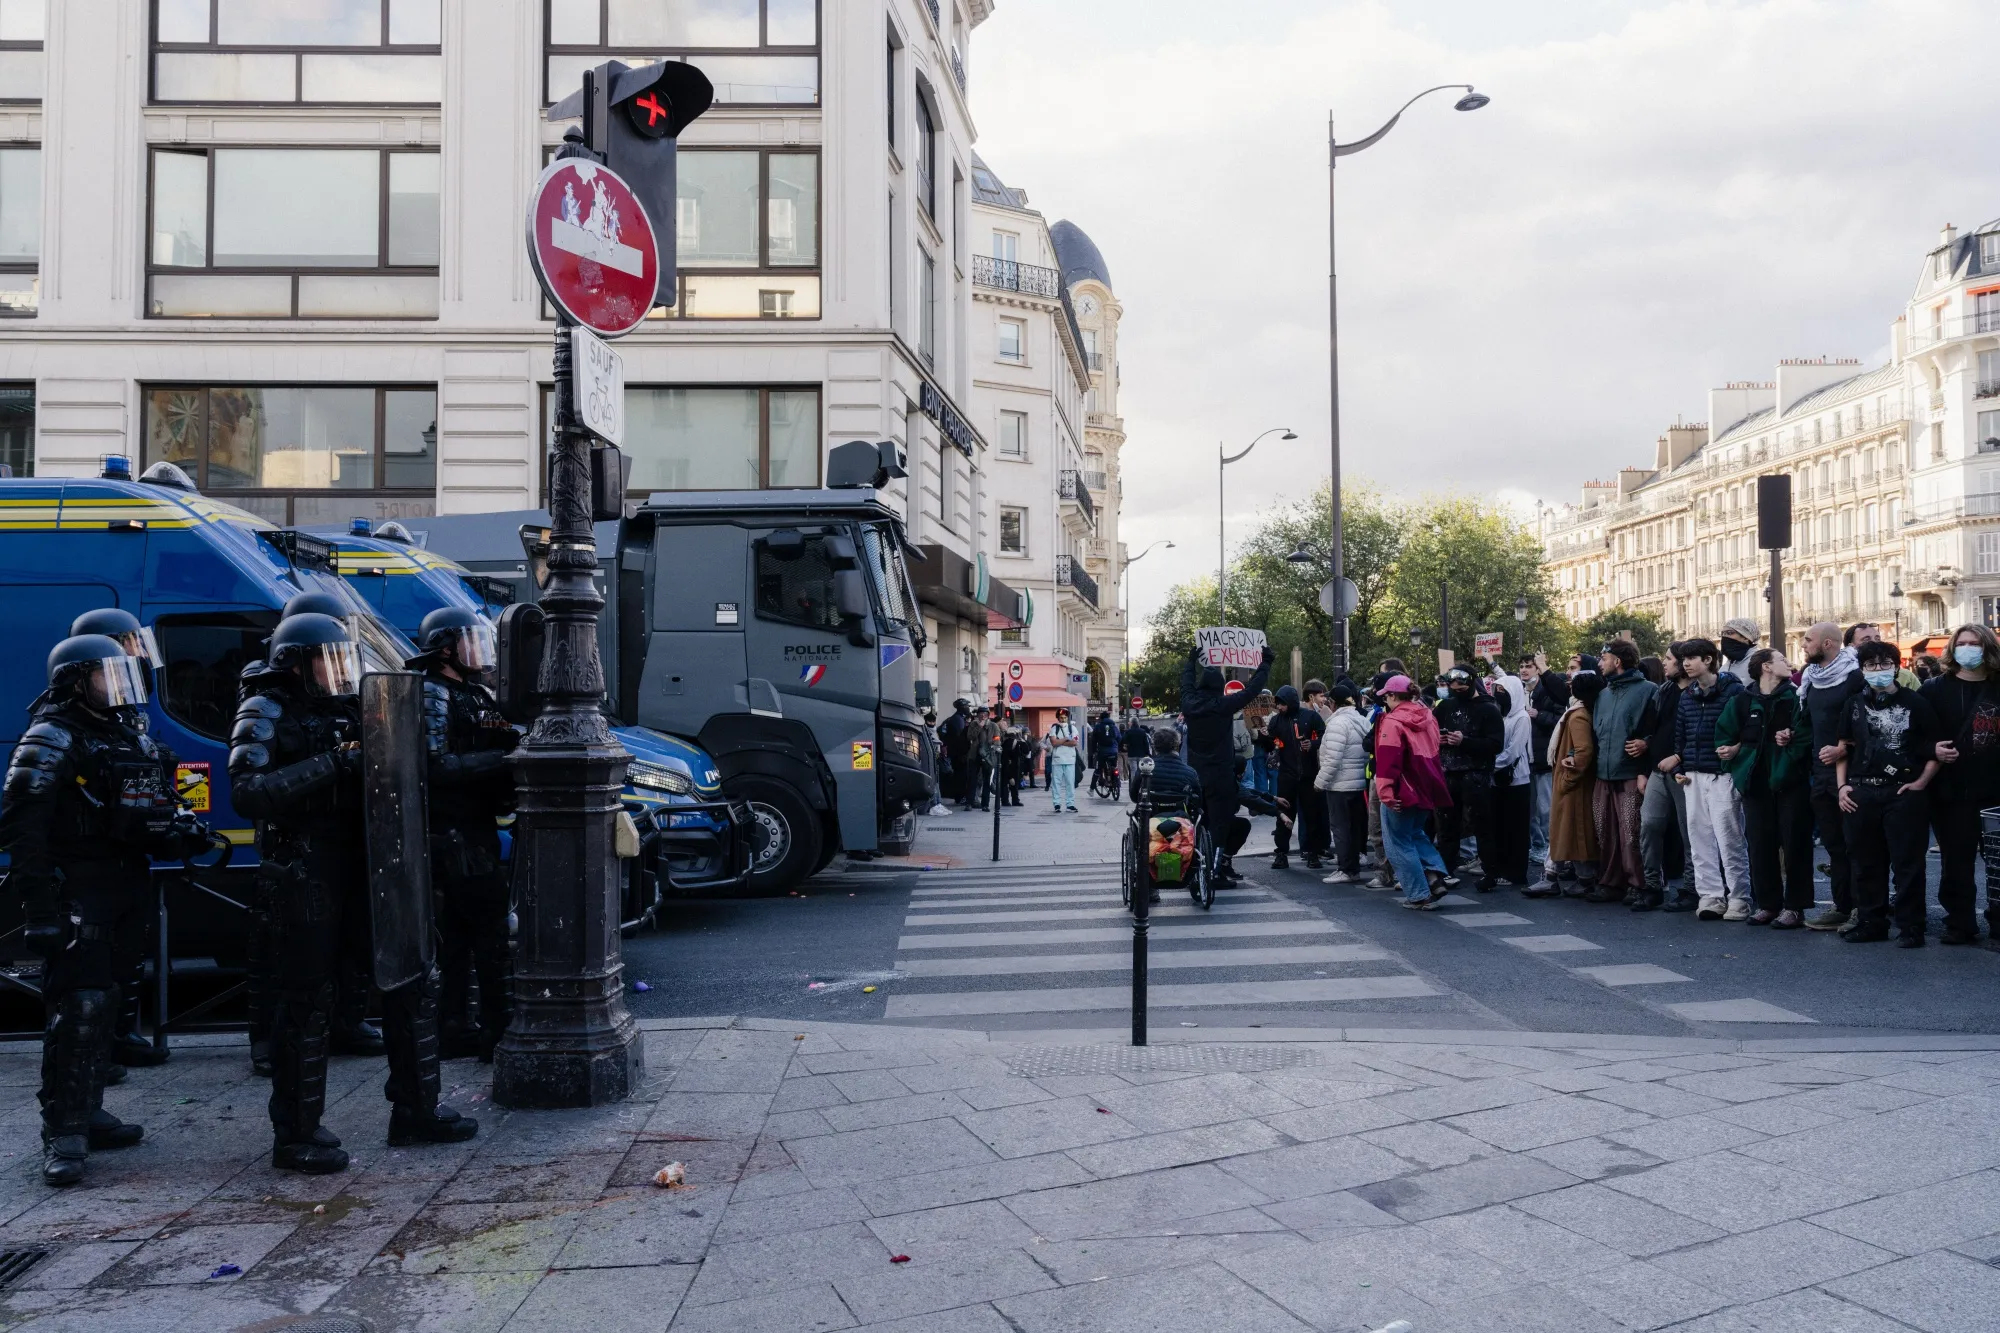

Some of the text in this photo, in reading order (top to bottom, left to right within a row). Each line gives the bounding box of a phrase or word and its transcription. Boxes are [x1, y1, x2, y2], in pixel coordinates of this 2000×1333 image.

[590, 341, 614, 375] SAUF
[922, 382, 974, 456] BNP PARIBAS
[784, 645, 842, 655] POLICE
[1198, 630, 1254, 648] MACRON
